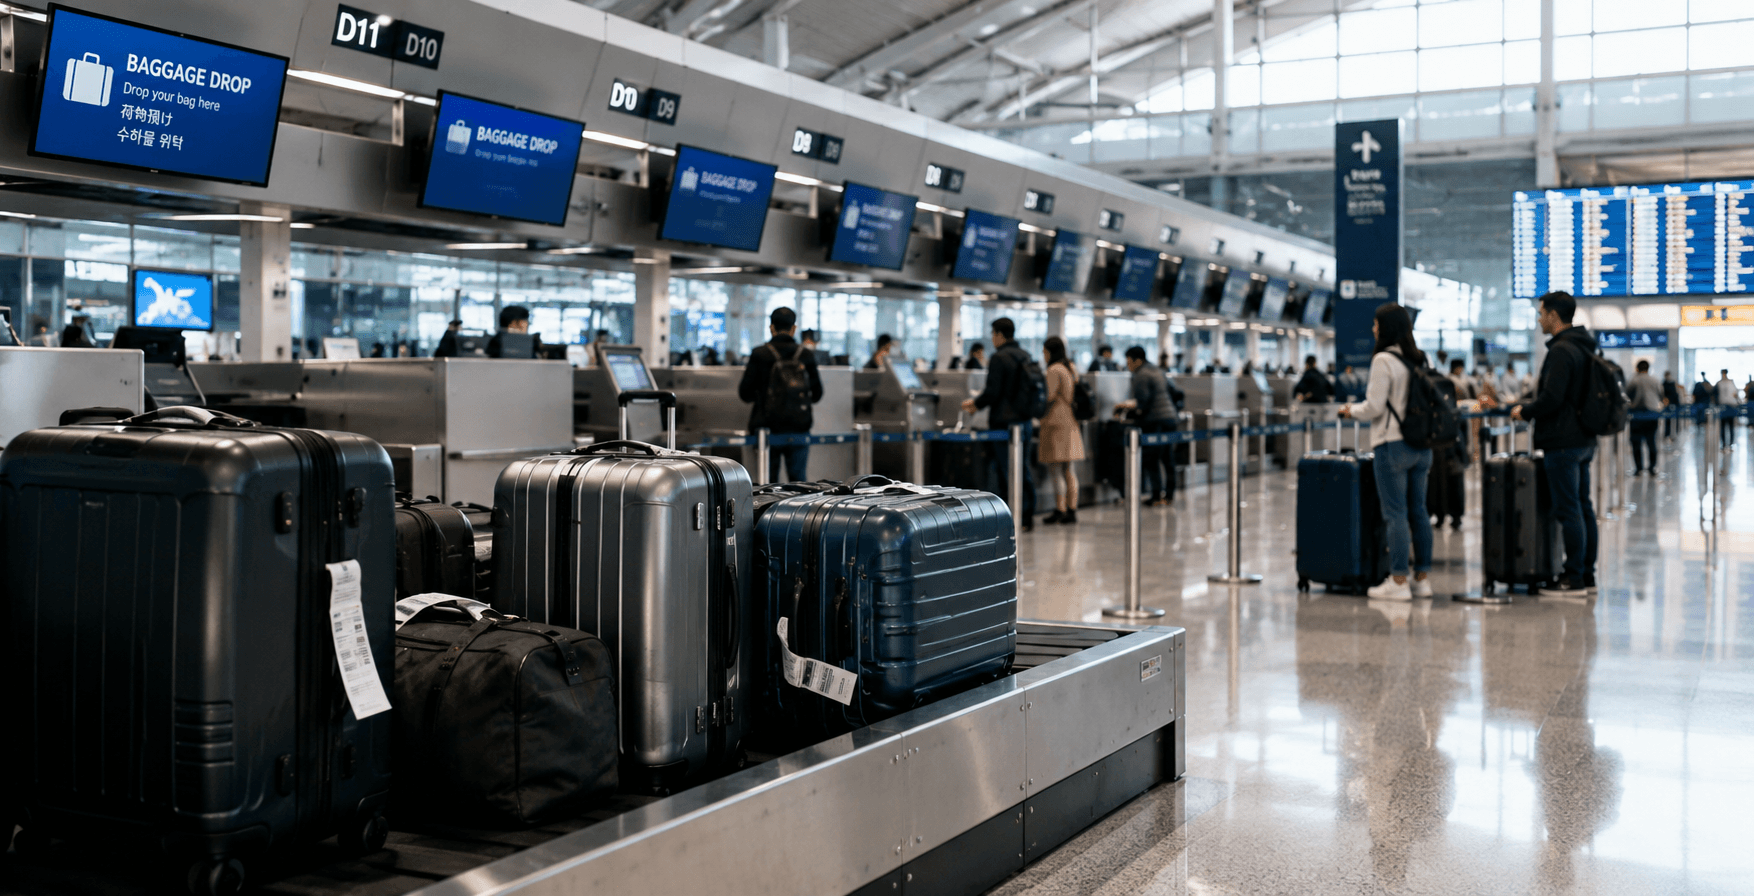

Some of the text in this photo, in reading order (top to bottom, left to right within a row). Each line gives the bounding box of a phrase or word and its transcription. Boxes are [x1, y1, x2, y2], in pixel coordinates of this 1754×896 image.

[336, 12, 380, 49] D11
[405, 32, 438, 60] D10
[126, 53, 252, 94] BAGGAGE DROP
[123, 82, 221, 112] Drop your bag here
[657, 97, 676, 119] D9
[476, 126, 559, 155] BAGGAGE DROP
